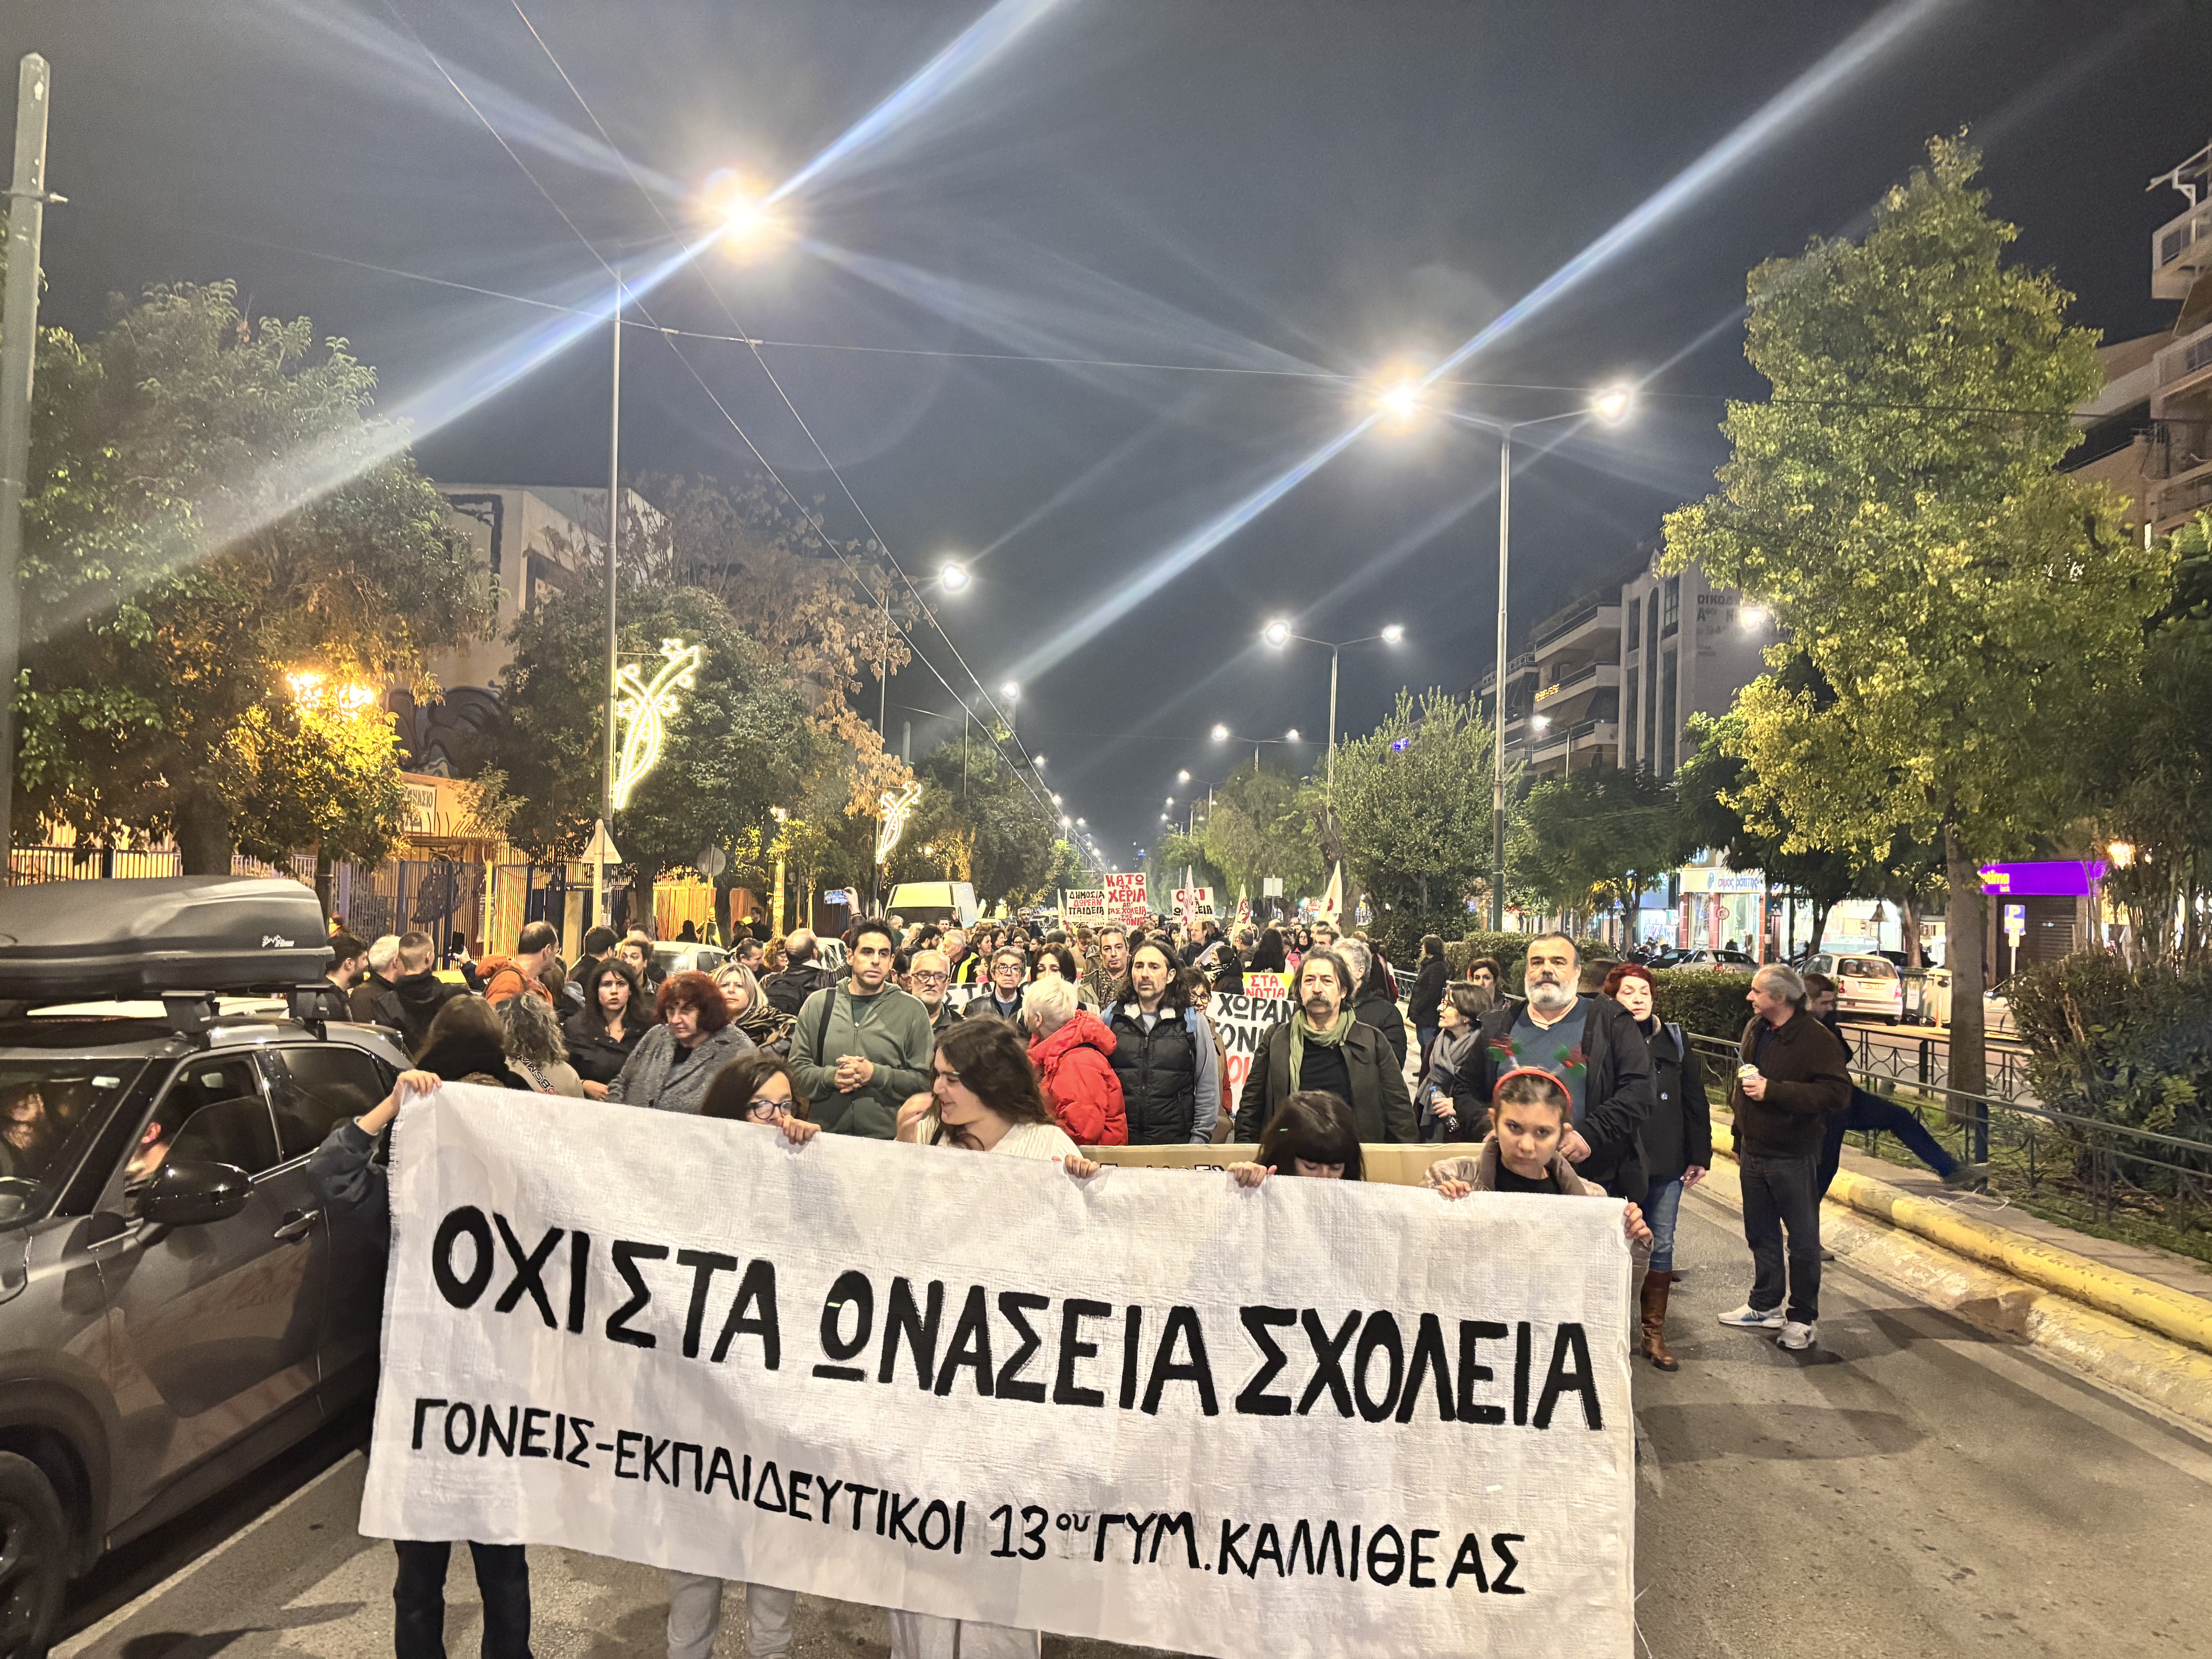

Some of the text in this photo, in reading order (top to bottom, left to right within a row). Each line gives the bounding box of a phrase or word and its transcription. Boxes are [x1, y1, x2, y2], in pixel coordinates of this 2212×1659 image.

[1105, 874, 1144, 887] ΚΑΤΩ
[1069, 891, 1104, 899] ΔΗΜΟΣΙΑ
[1109, 888, 1146, 903] ΧΕΡΙΑ
[1176, 889, 1205, 902] ΟΙ
[1073, 898, 1102, 907] ΔΩΡΕΑΝ
[1068, 907, 1104, 915] ΠΑΙΔΕΙΑ
[1115, 906, 1146, 916] ΣΧΟΛΕΙΑ
[1250, 975, 1278, 987] ΣΤΑ
[1246, 988, 1285, 998] ΝΟΤΙΑ
[432, 1206, 1602, 1431] ΟΧΙ ΣΤΑ ΩΝΑΣΕΙΑ ΣΧΟΛΕΙΑ
